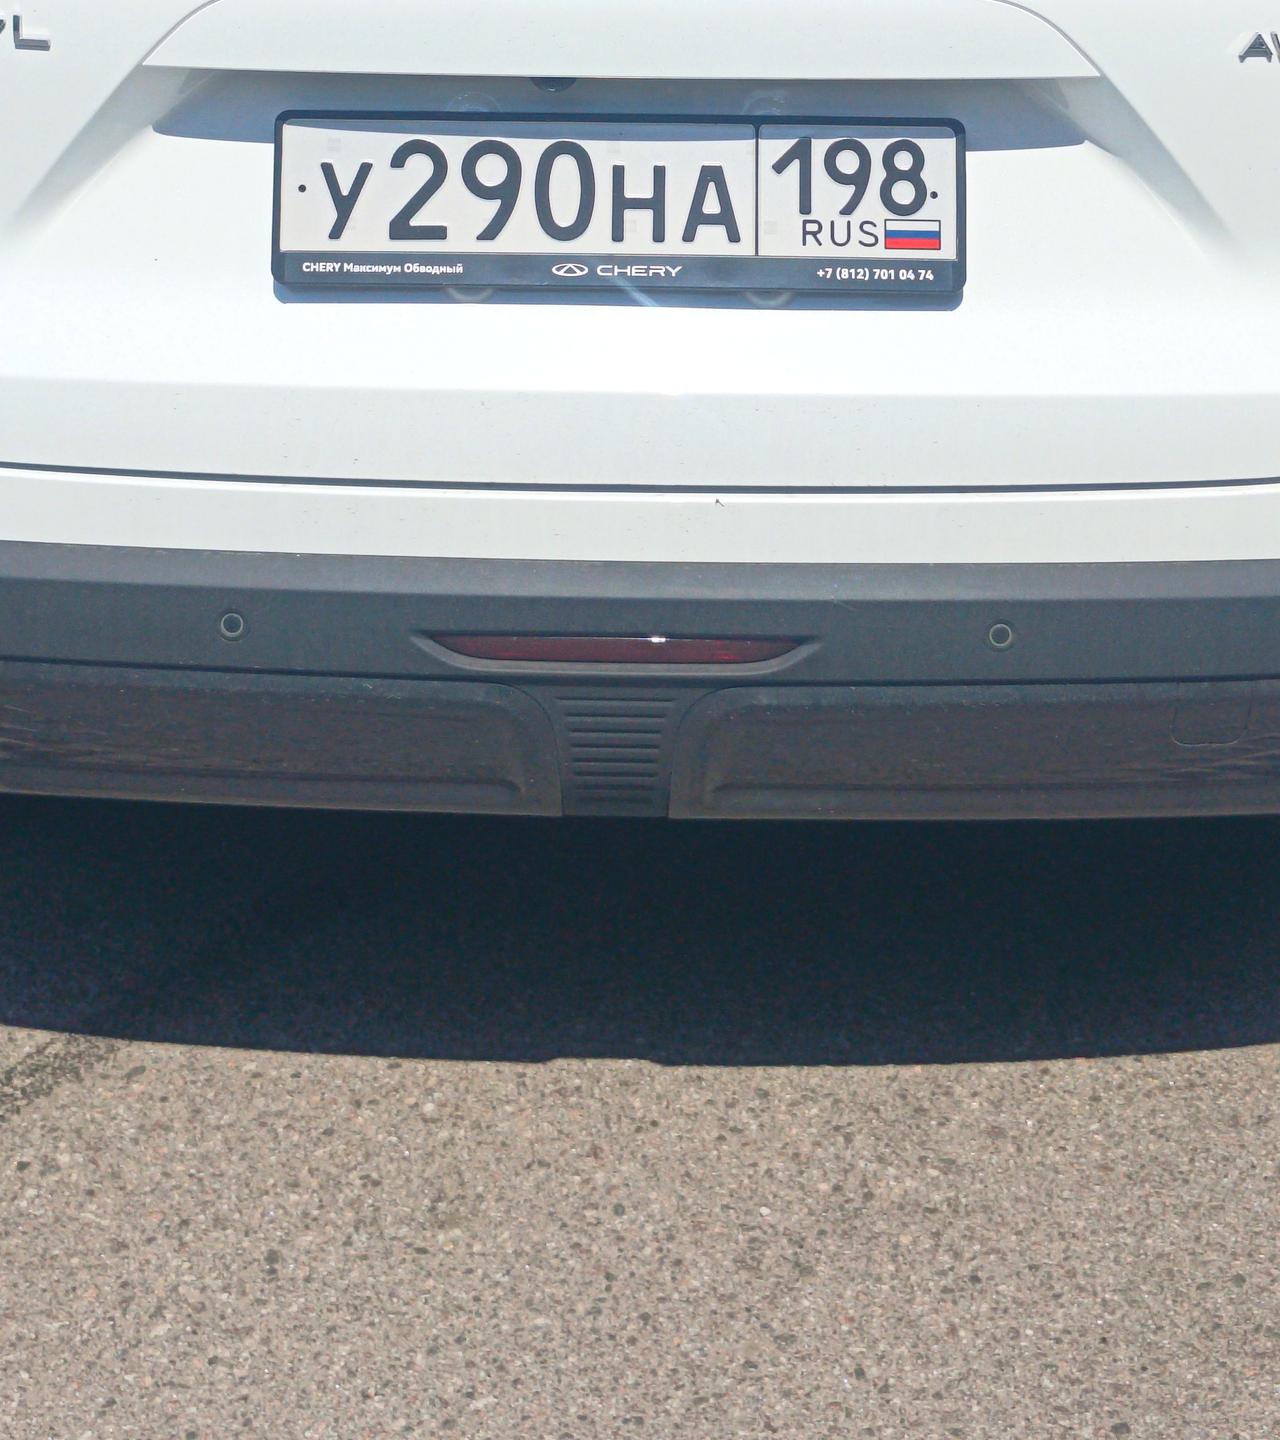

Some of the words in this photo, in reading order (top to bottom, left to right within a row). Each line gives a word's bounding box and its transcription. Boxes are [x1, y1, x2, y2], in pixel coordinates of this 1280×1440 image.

[771, 136, 928, 217] 198
[802, 219, 879, 248] RUS
[302, 262, 342, 273] CHERY
[343, 262, 402, 275] Максимум
[403, 262, 464, 275] Обводный
[596, 264, 683, 278] CHERY
[816, 267, 833, 279] +7
[835, 267, 870, 281] (812)
[872, 268, 896, 281] 701
[898, 269, 916, 281] 04
[917, 269, 935, 282] 74
